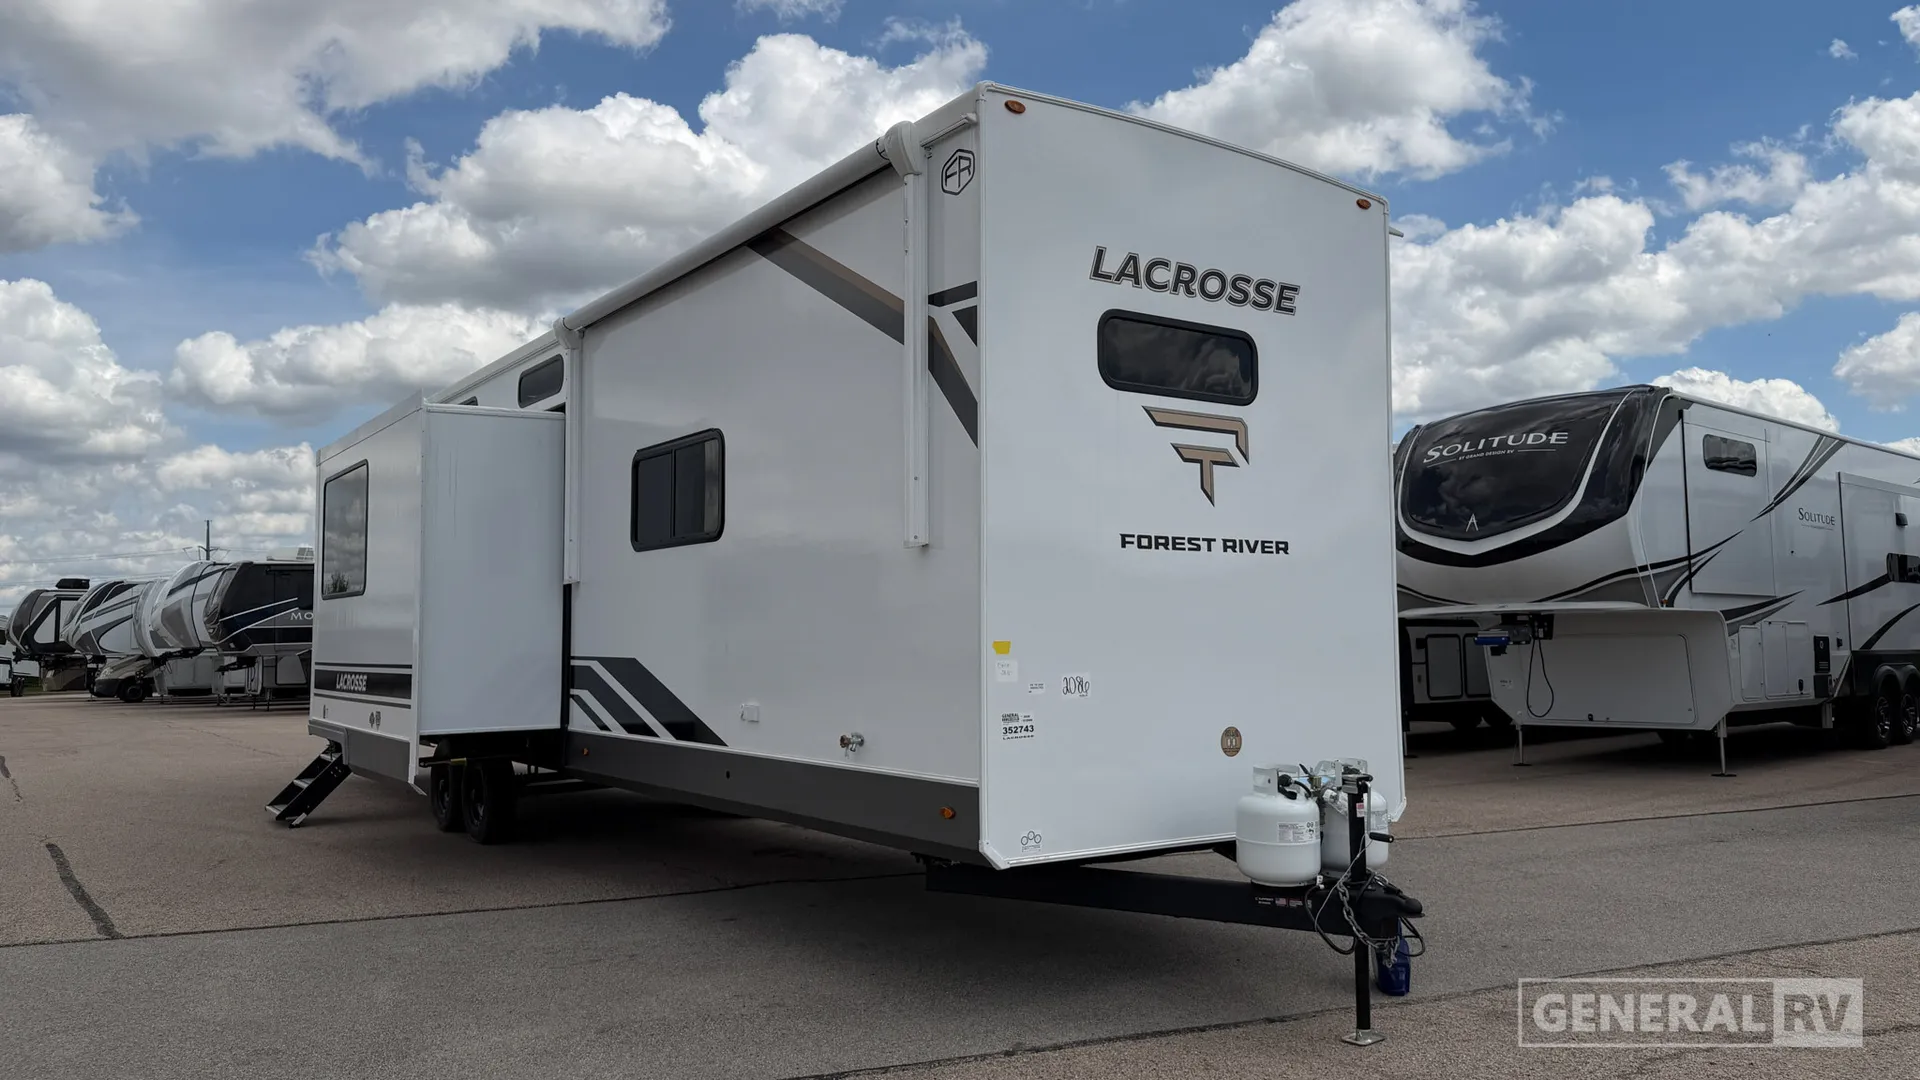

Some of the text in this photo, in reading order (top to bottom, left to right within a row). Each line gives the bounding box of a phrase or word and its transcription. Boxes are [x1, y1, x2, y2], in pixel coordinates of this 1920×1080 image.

[1089, 245, 1300, 316] LACROSSE
[1423, 432, 1569, 463] SOLITUDE
[1466, 452, 1484, 460] GRAND
[1485, 449, 1506, 457] DESIGN
[1119, 533, 1290, 555] FOREST RIVER
[336, 673, 368, 692] LACROSSE
[1002, 724, 1035, 735] 352743
